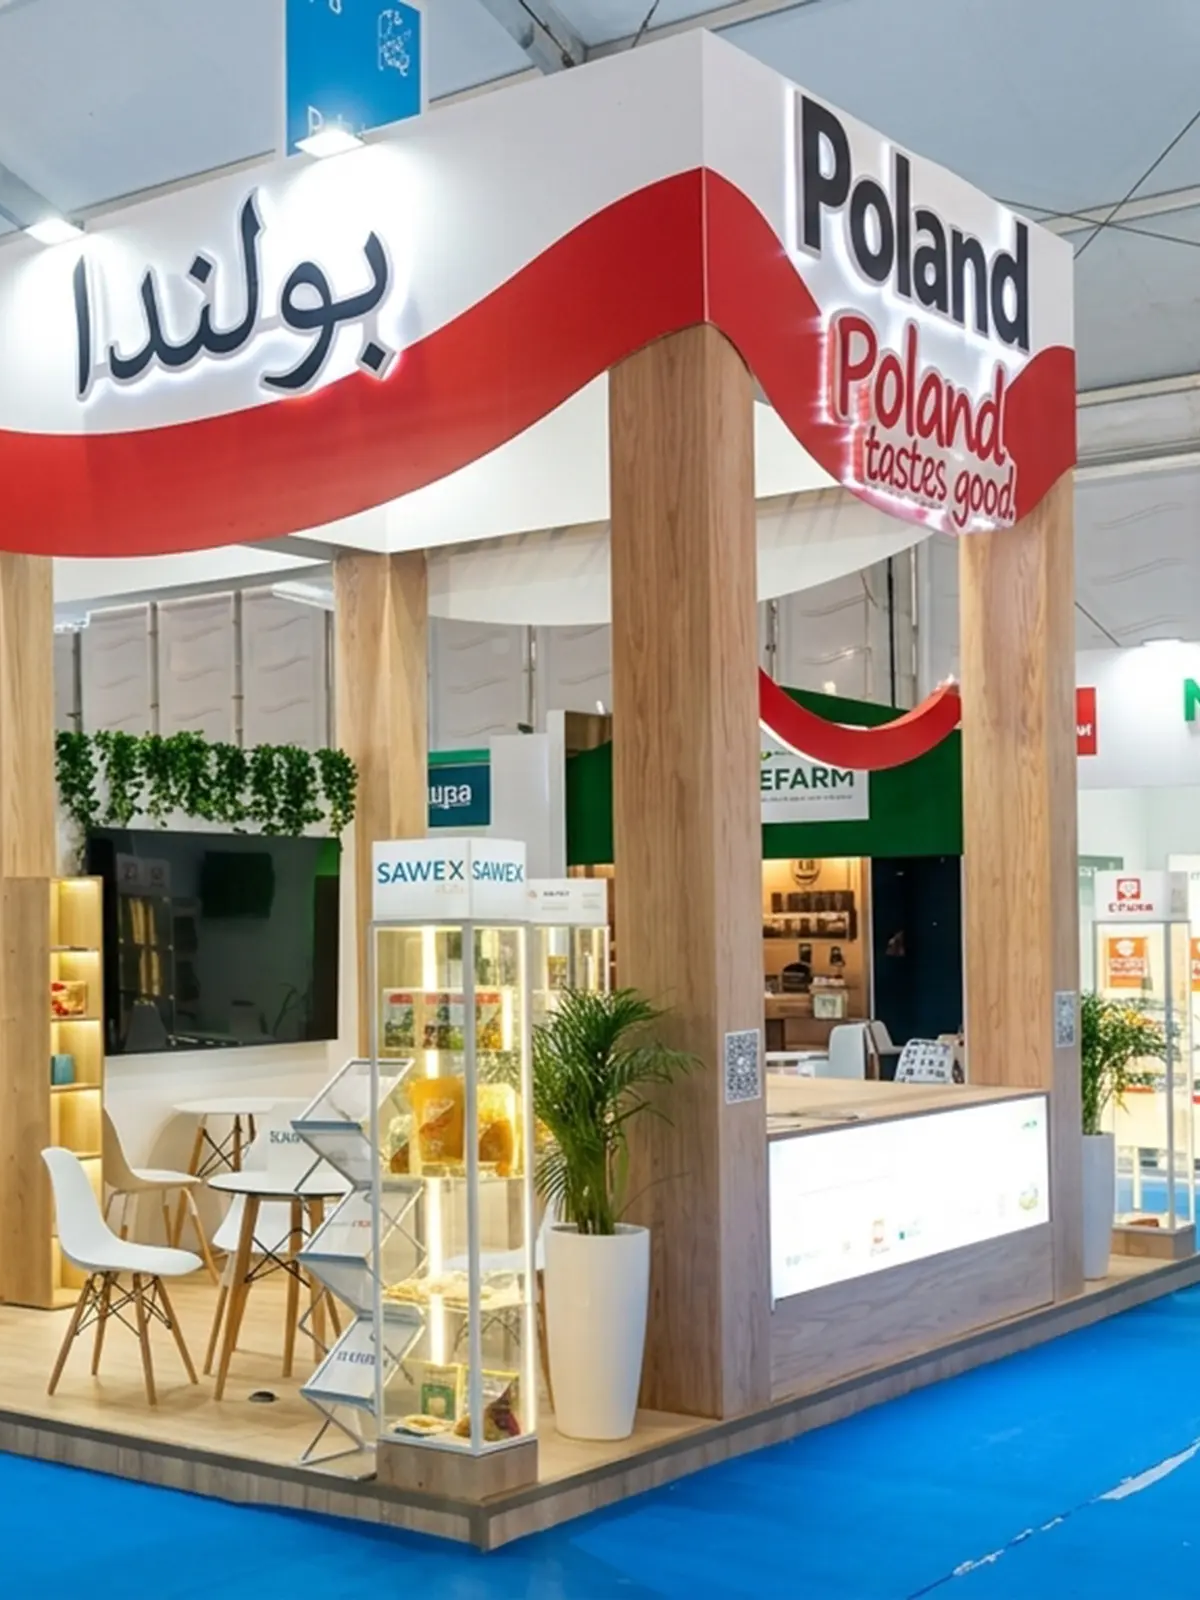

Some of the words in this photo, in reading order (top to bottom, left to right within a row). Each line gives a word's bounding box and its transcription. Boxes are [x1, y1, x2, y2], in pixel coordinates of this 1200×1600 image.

[72, 193, 390, 396] بولندا
[800, 93, 1030, 354] Poland
[837, 315, 1006, 467] Poland
[865, 425, 948, 502] tastes
[471, 860, 524, 883] SAWEX
